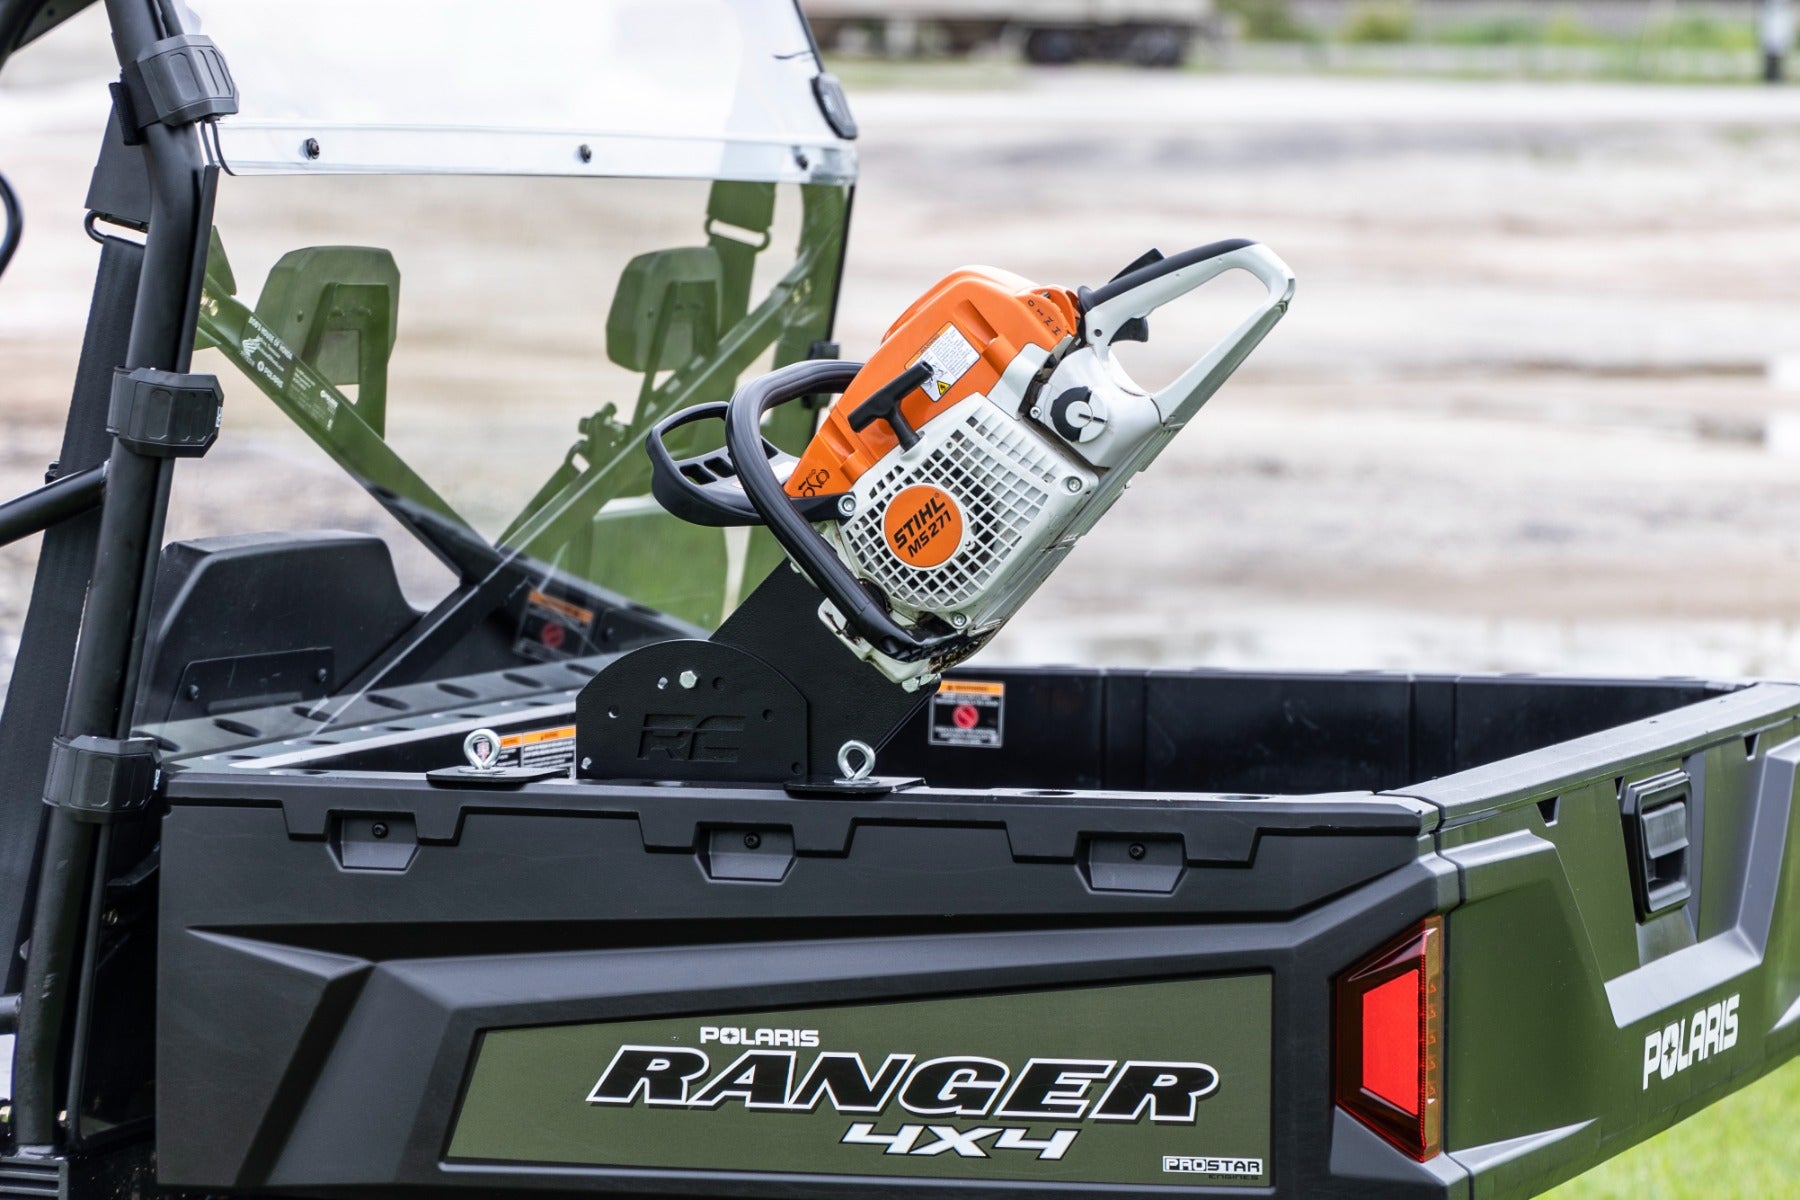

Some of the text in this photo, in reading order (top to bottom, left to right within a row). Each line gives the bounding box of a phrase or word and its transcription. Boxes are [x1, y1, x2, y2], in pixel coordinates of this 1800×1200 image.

[893, 497, 946, 550] STIHL
[700, 1026, 820, 1047] POLARIS
[1642, 993, 1740, 1091] POLARIS
[585, 1044, 1219, 1124] RANGER
[1163, 1157, 1262, 1174] PROSTAR
